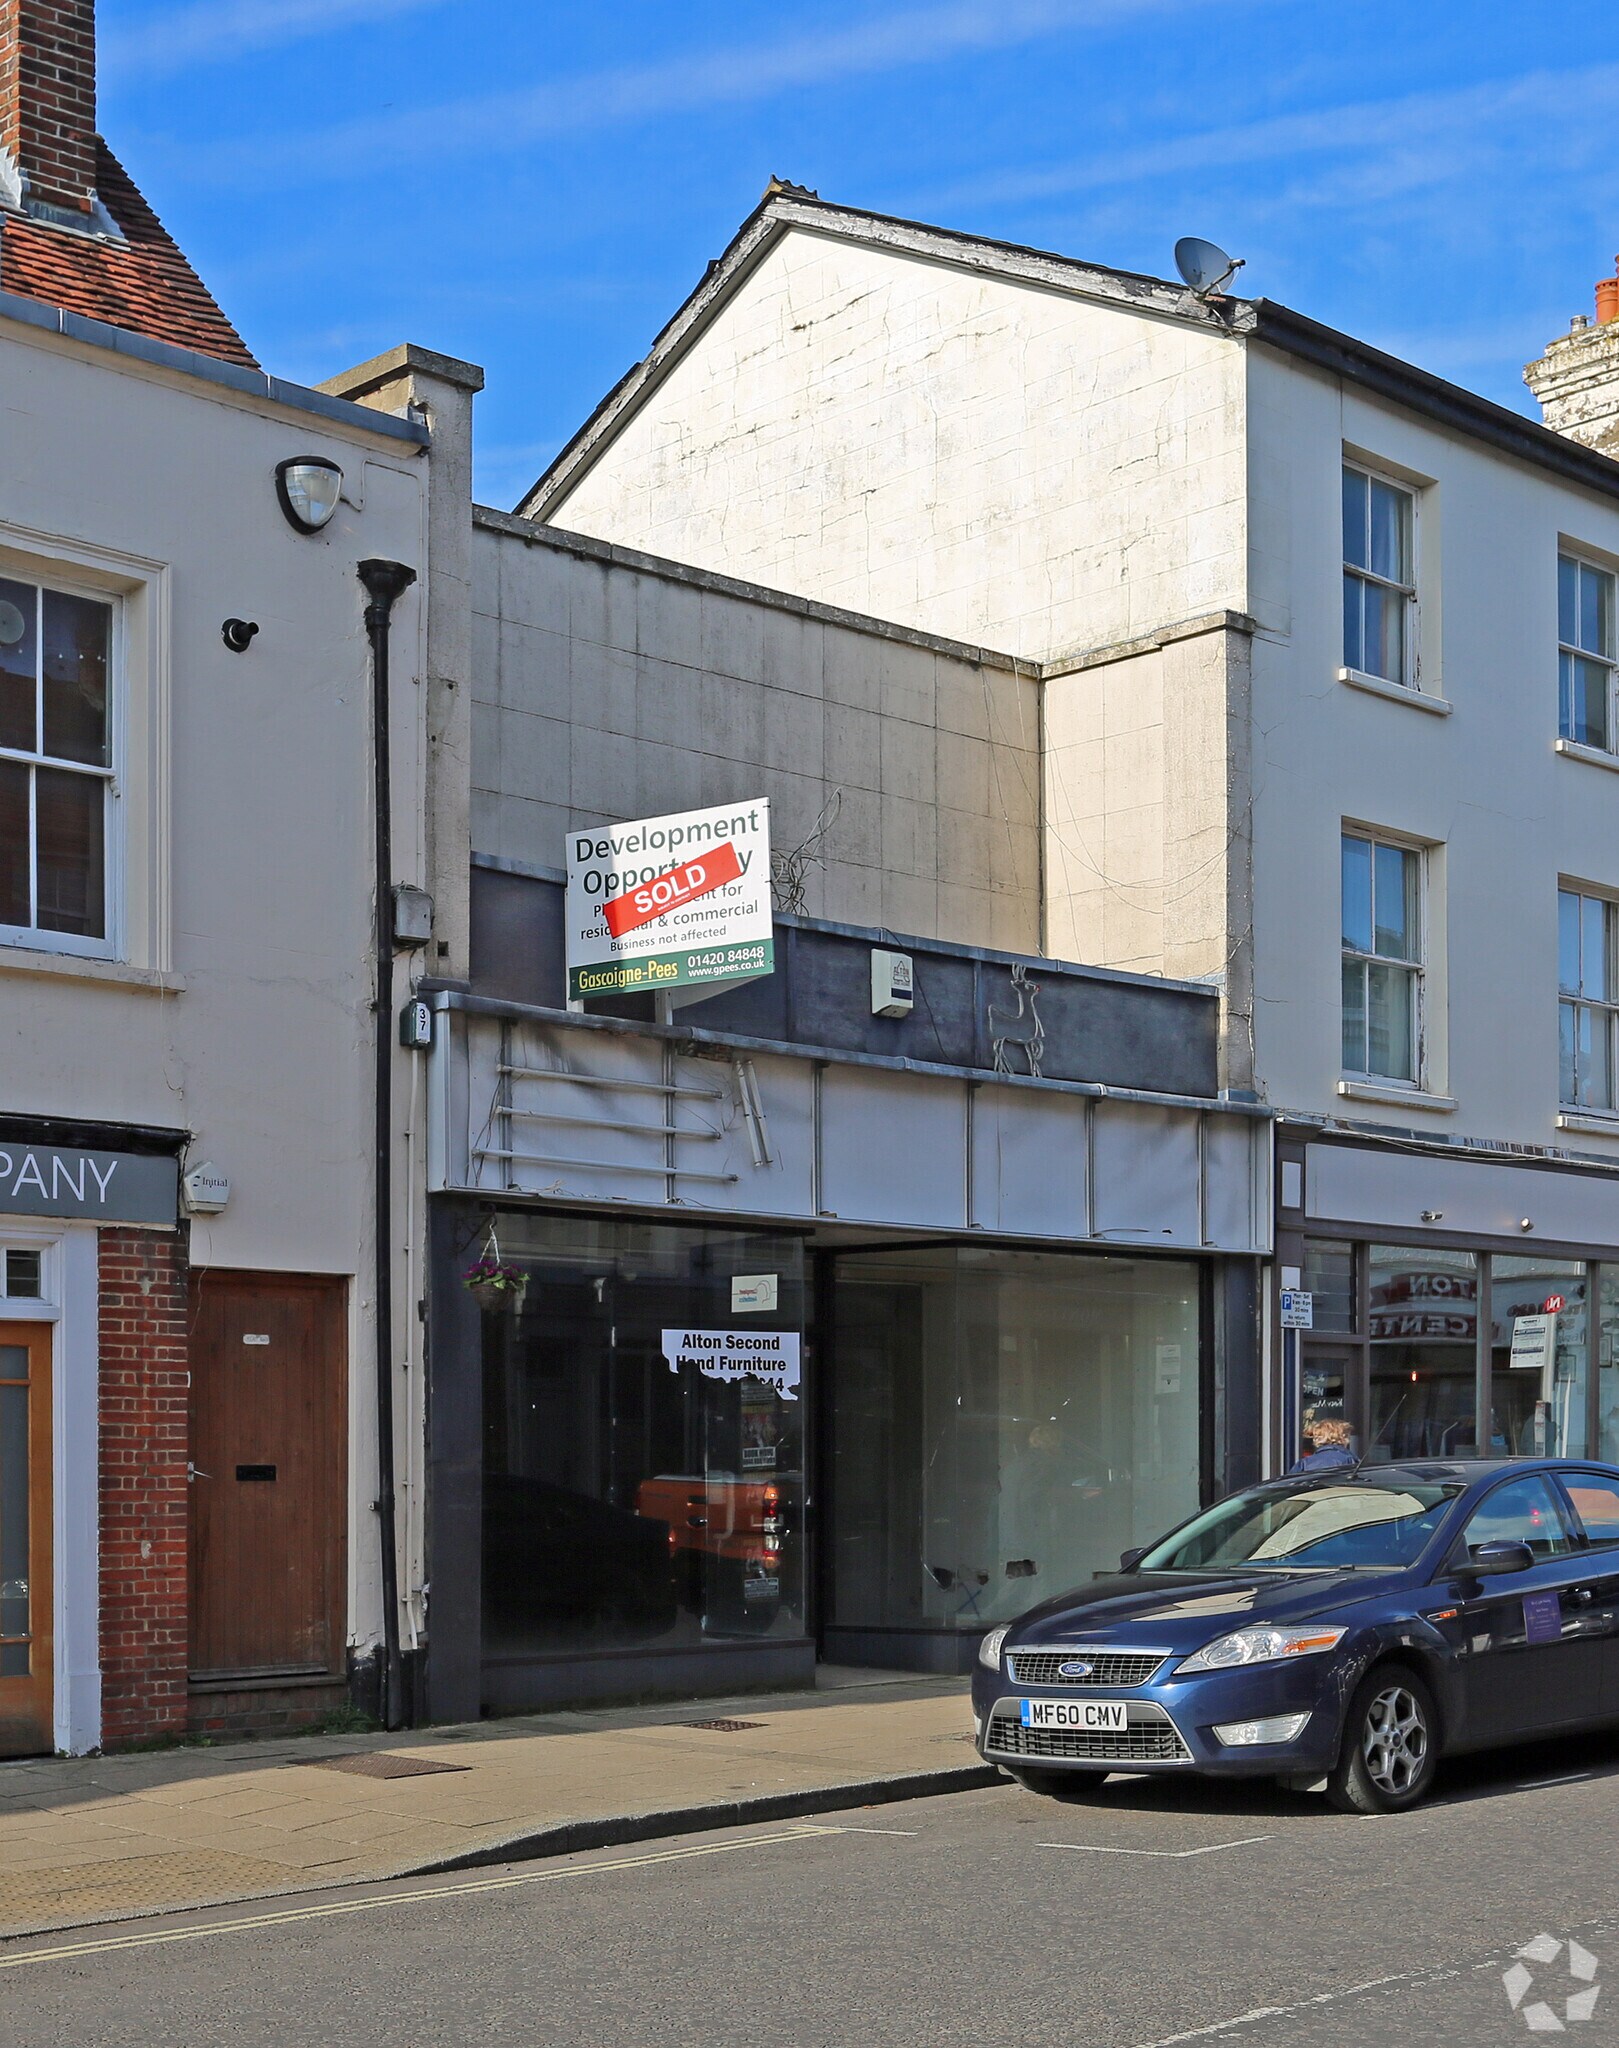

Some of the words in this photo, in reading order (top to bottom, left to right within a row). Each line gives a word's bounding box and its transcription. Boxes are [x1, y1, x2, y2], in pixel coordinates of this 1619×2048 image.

[576, 809, 759, 862] Development
[583, 850, 752, 898] Opporty
[635, 864, 706, 913] SOLD
[722, 883, 743, 899] for
[658, 914, 668, 928] &
[673, 899, 758, 925] commercial
[610, 938, 655, 952] Business
[659, 933, 677, 945] not
[681, 925, 727, 941] affected
[688, 952, 724, 968] 01420
[728, 946, 765, 963] 84848
[688, 959, 765, 977] www.gpees.co.uk
[579, 960, 678, 989] Gascoigne-Pees
[202, 1177, 228, 1187] Initial
[682, 1333, 721, 1349] Alton
[725, 1335, 780, 1350] Second
[720, 1355, 786, 1371] Furniture
[1033, 1704, 1079, 1726] MF60
[1085, 1706, 1122, 1727] CMV
